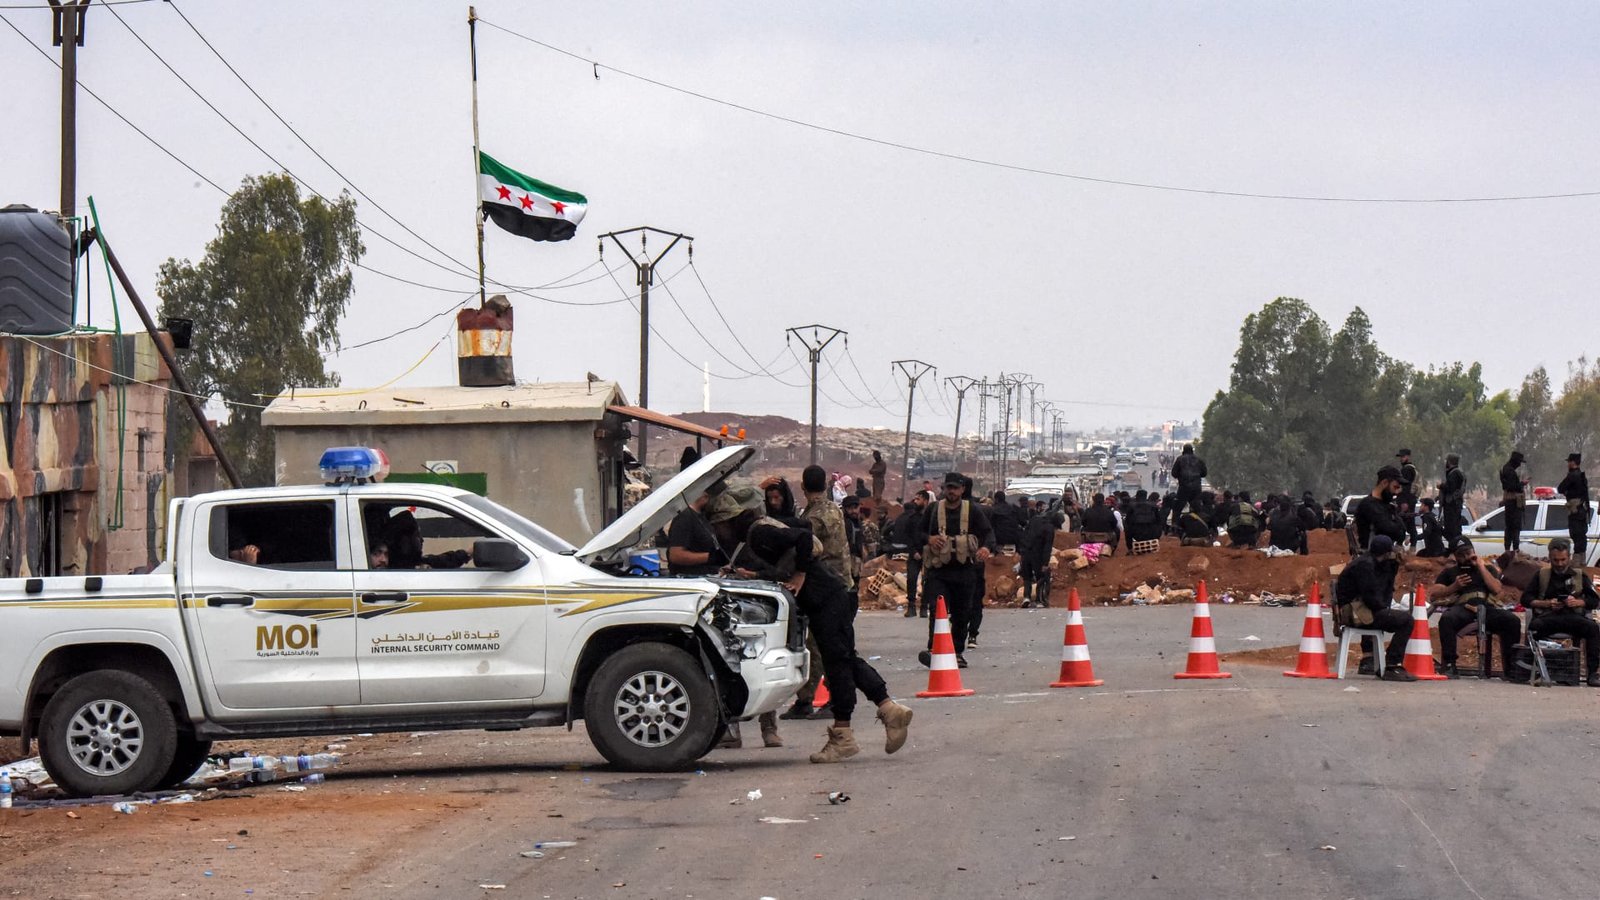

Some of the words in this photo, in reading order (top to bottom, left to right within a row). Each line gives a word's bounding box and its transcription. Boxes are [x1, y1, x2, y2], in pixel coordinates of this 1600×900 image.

[256, 624, 318, 650] MOI
[371, 632, 424, 646] الداخلي
[426, 630, 461, 642] الأمن
[464, 630, 500, 640] قيادة
[371, 645, 412, 654] INTERNAL
[414, 644, 453, 652] SECURITY
[455, 643, 500, 651] COMMAND
